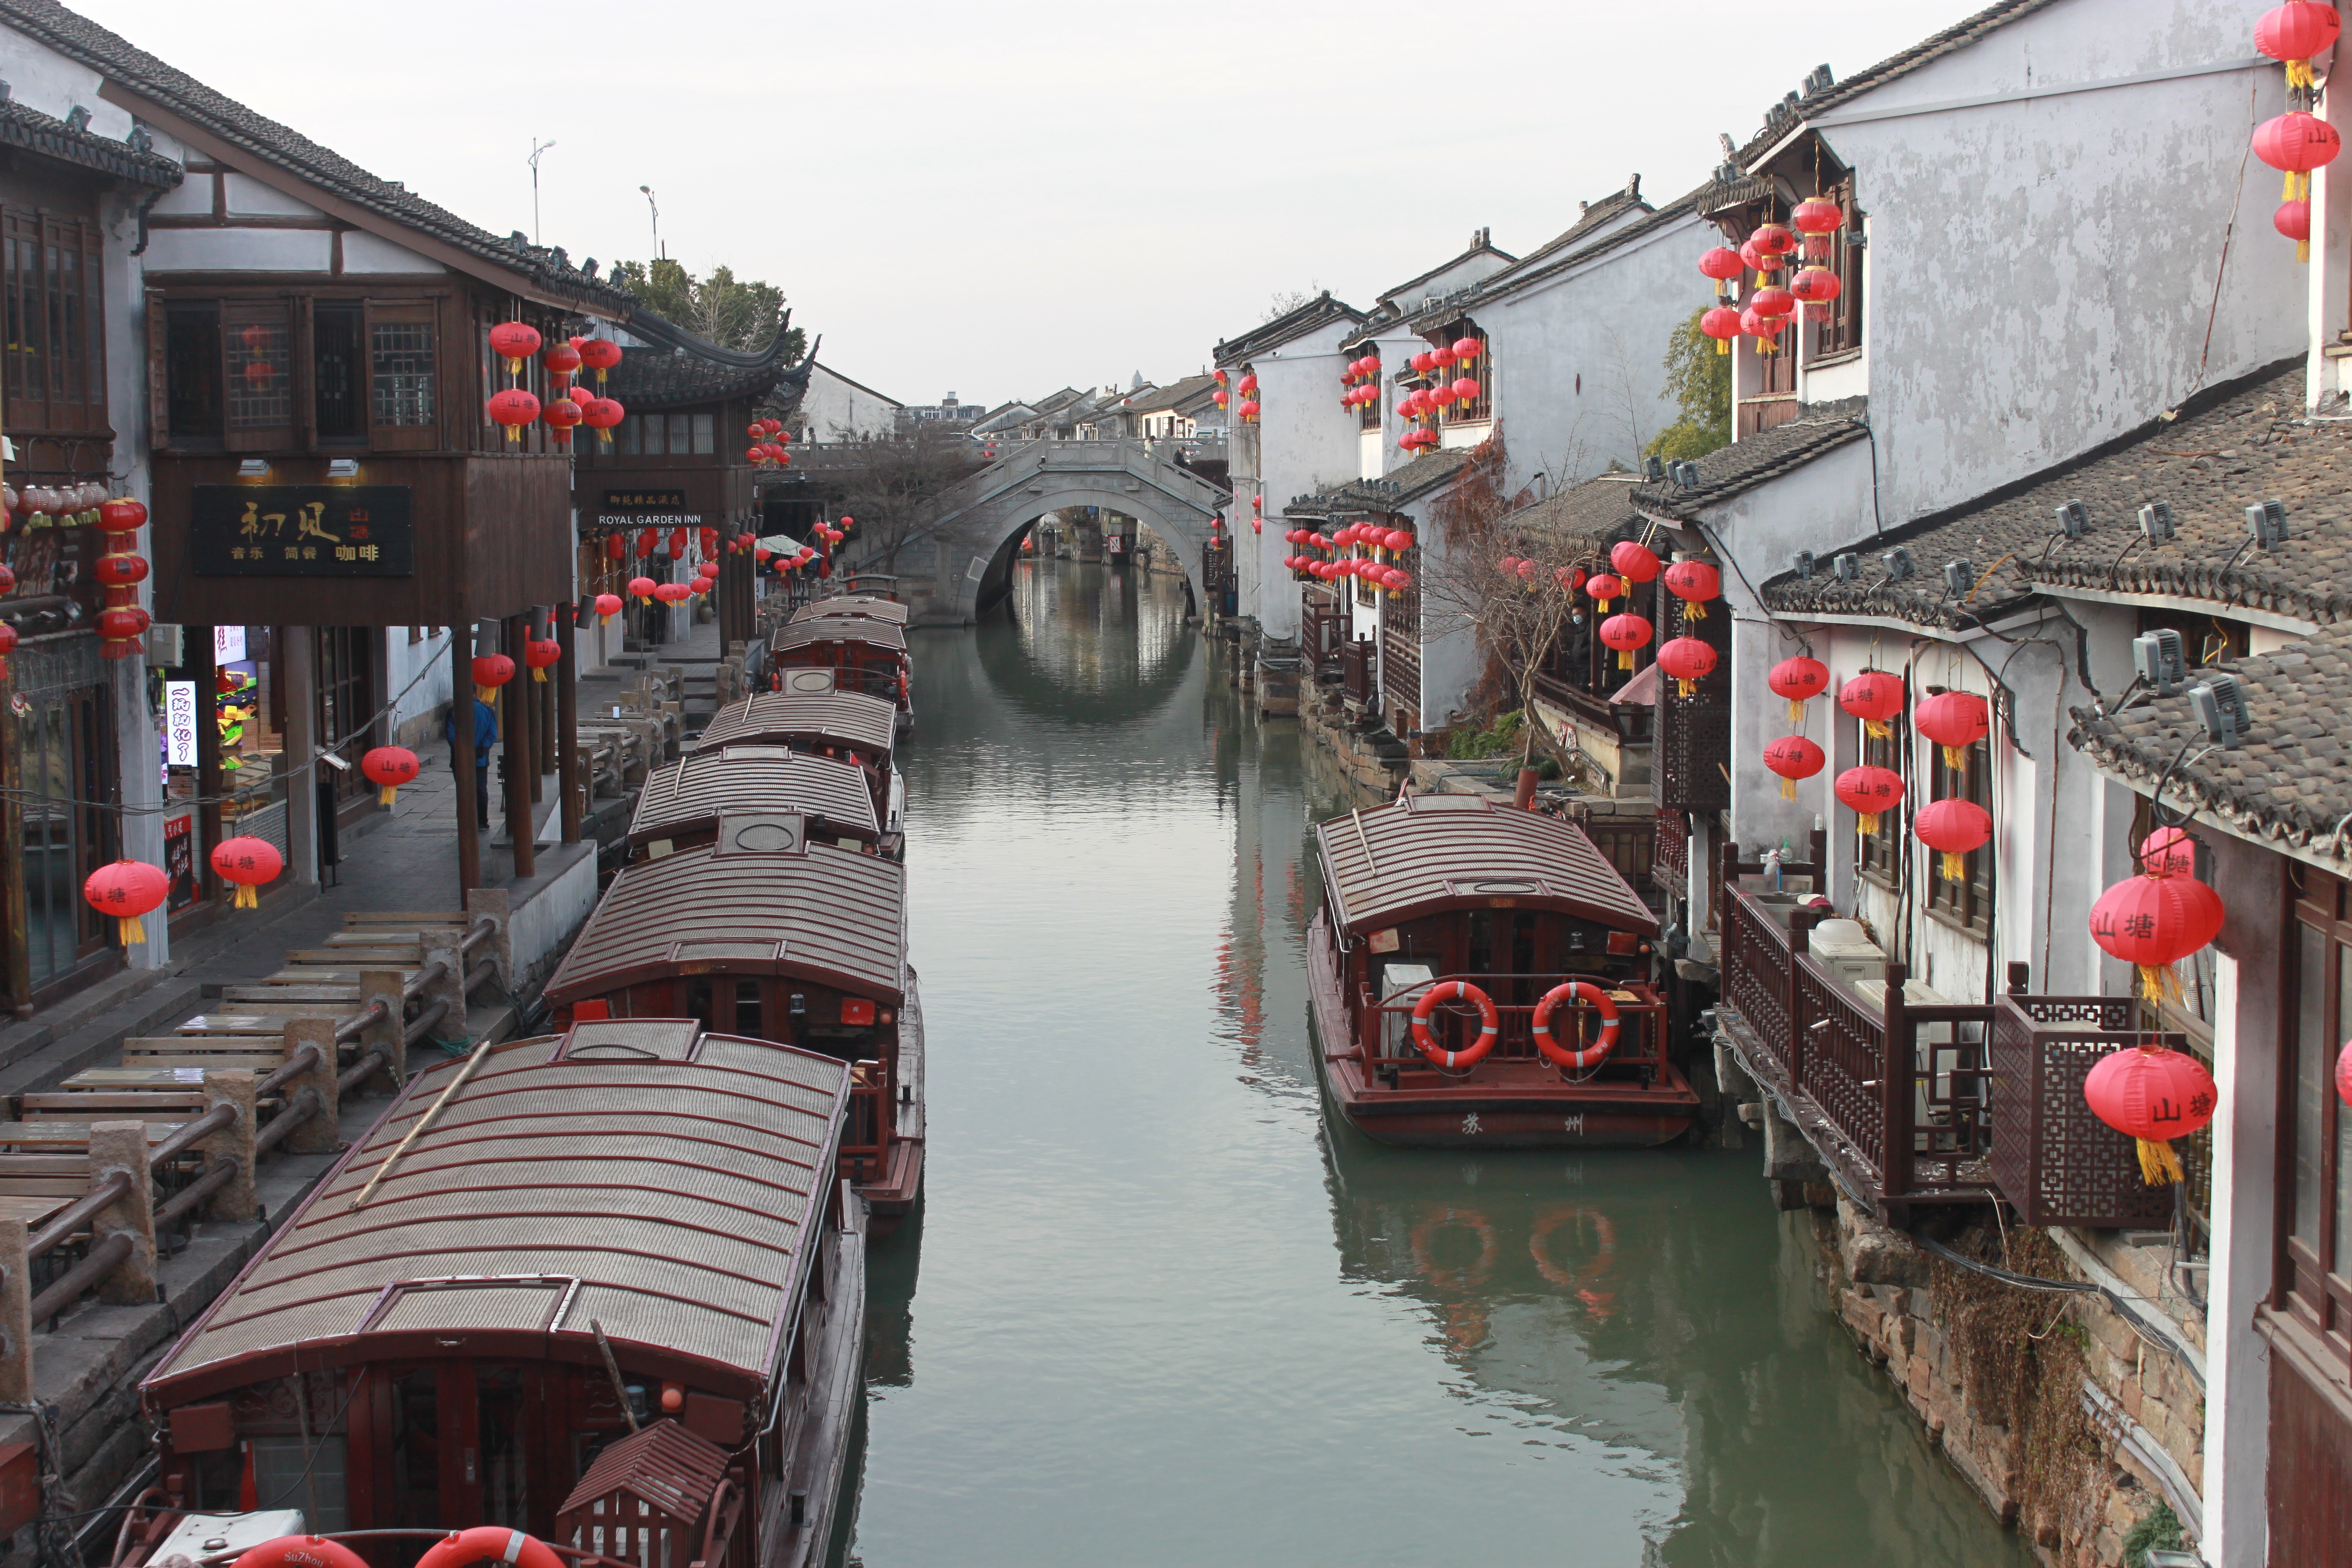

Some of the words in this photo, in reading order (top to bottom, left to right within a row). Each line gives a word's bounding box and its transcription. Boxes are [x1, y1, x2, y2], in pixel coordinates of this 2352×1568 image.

[511, 333, 536, 343] 山塘
[586, 347, 607, 356] 山塘
[508, 398, 534, 409] 山塘
[588, 406, 609, 417] 山塘
[610, 494, 680, 505] 御苑精品酒店
[241, 502, 341, 543] 初见
[599, 516, 633, 524] ROYAL
[637, 515, 681, 524] GARDEN
[231, 547, 264, 559] 音乐
[284, 546, 317, 560] 简餐
[336, 544, 379, 561] 咖啡
[1669, 574, 1694, 588] 山塘
[1611, 630, 1637, 641] 山塘
[1785, 673, 1816, 685] 山塘
[1845, 689, 1873, 702] 山塘
[172, 687, 191, 761] 一抿就化了
[1772, 747, 1803, 763] 山塘
[381, 760, 411, 773] 山塘
[1855, 781, 1891, 797] 山塘
[220, 854, 255, 870] 山塘
[2149, 847, 2191, 874] 山塘
[91, 887, 126, 903] 山塘
[2096, 912, 2155, 938] 山塘
[2153, 1091, 2212, 1122] 山塘
[285, 1551, 324, 1568] SuZhou
